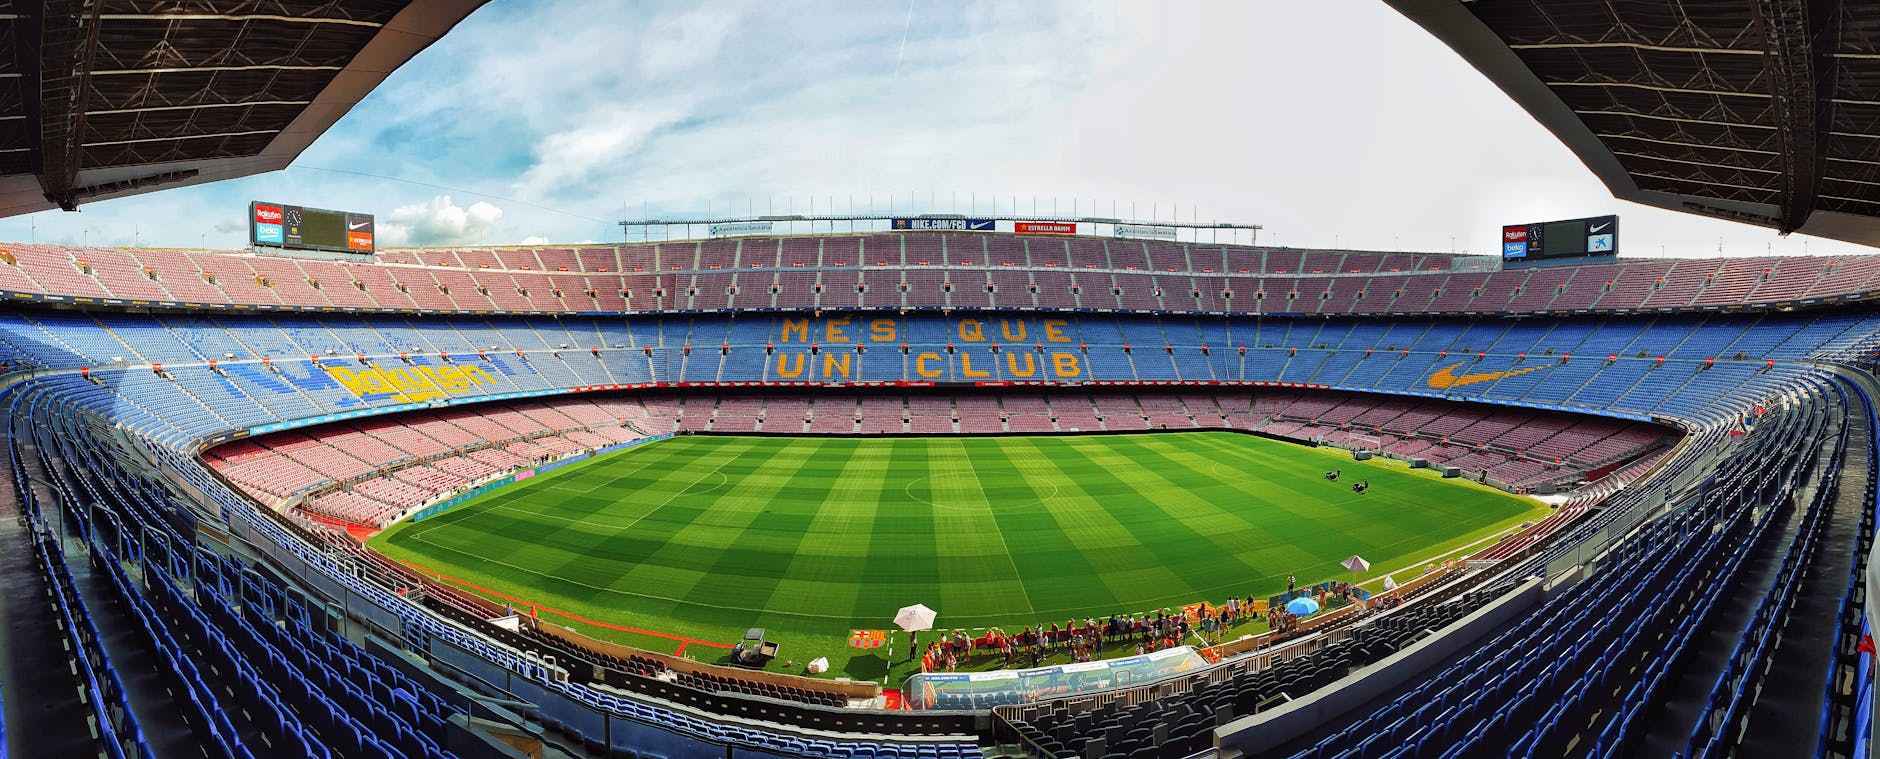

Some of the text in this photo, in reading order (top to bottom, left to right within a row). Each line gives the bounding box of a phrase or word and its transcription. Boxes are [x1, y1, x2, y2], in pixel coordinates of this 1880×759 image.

[912, 219, 967, 230] NIKE.COM/FCB
[958, 319, 1073, 342] QUE
[776, 352, 1081, 378] UN CLUB
